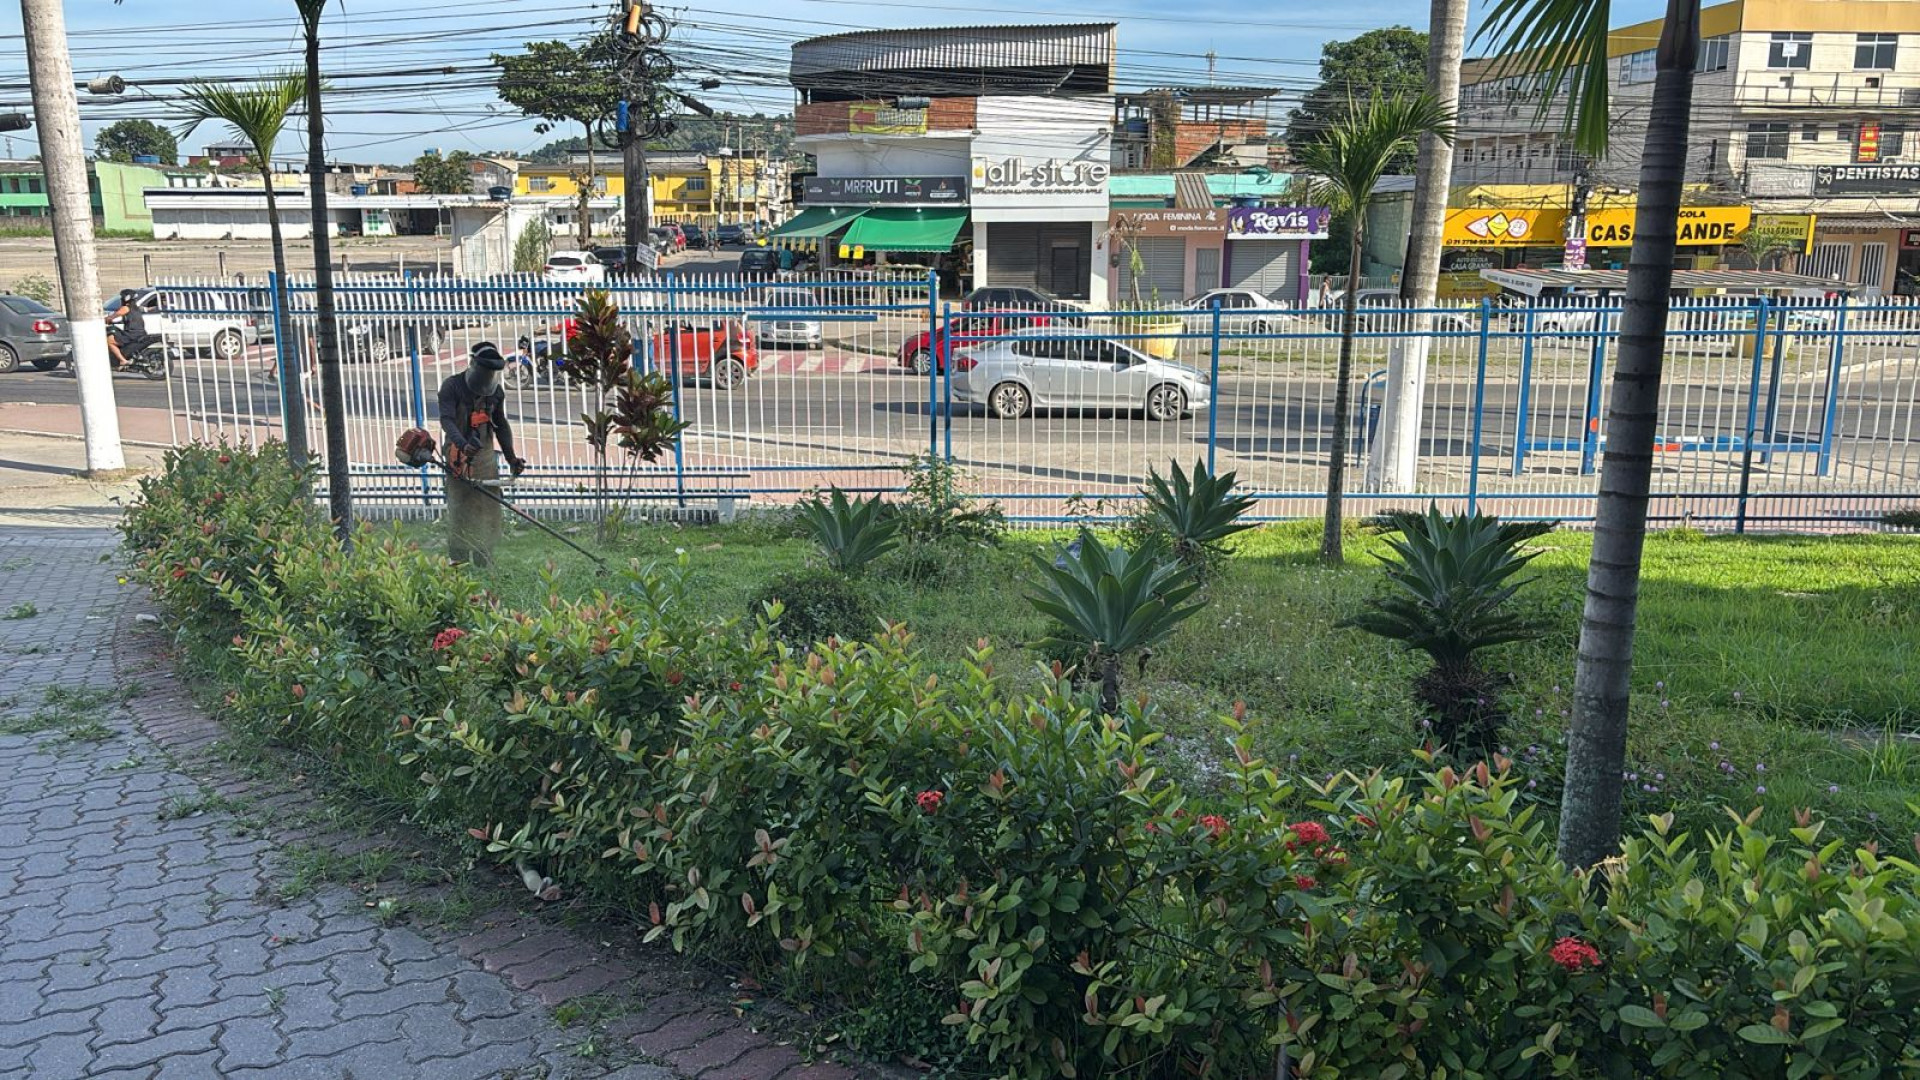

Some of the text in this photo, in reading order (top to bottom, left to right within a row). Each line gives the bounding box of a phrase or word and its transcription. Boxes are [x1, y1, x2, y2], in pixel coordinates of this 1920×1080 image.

[1835, 166, 1920, 180] DENTISTAS
[844, 179, 899, 194] MRFRUTI
[1163, 212, 1202, 221] FEMININA
[1678, 210, 1707, 218] COLA
[1591, 224, 1636, 242] CAS
[1677, 222, 1736, 240] ANDE
